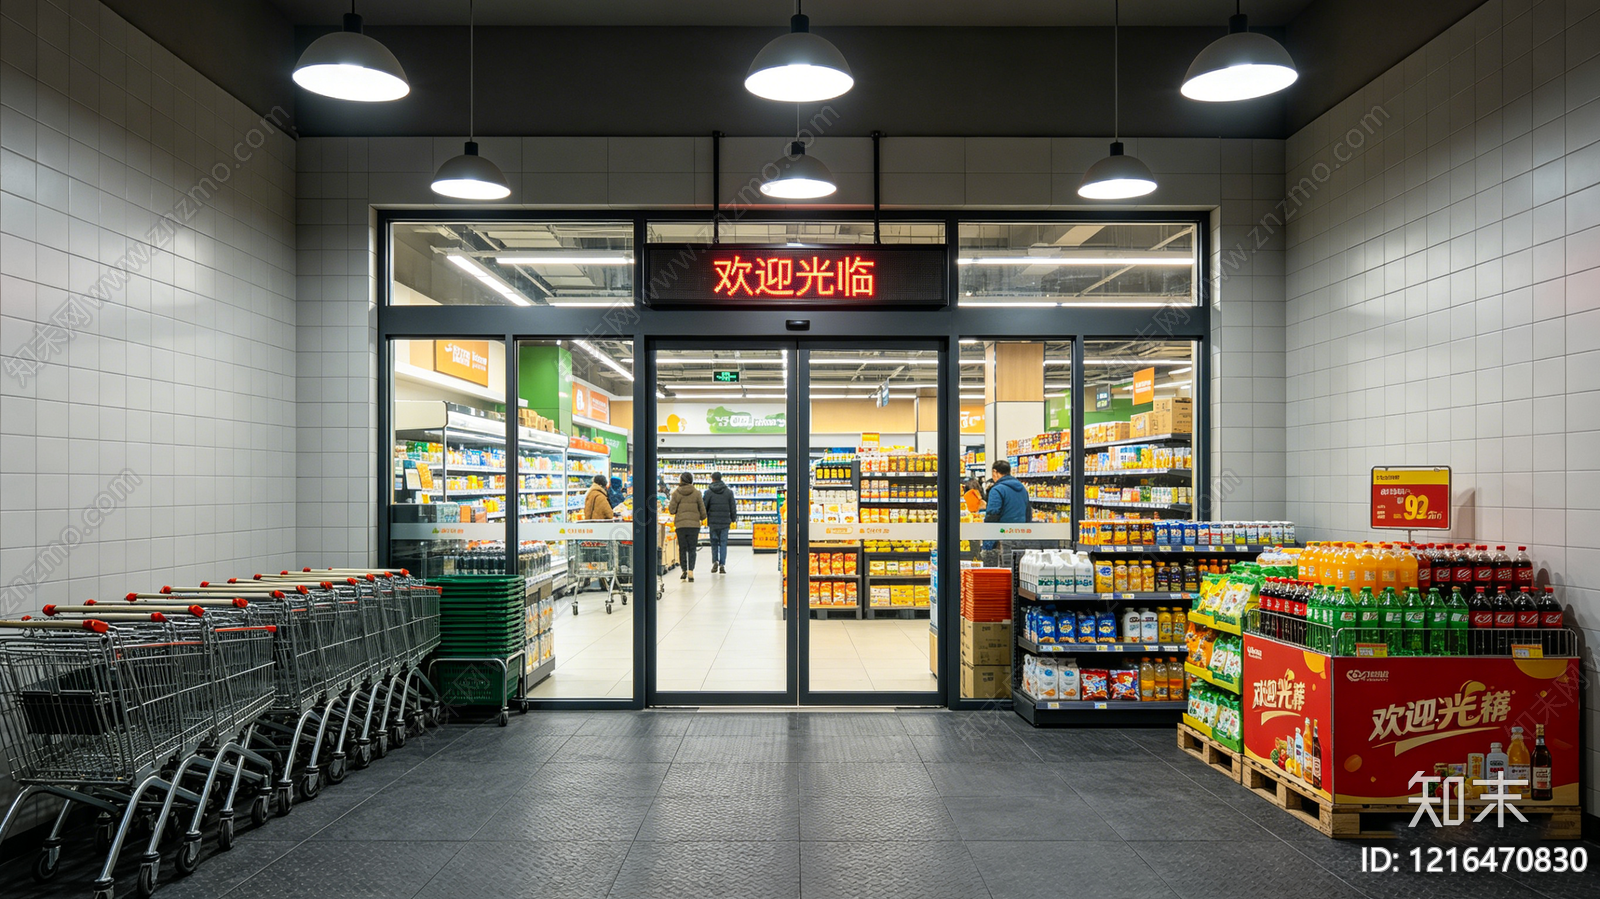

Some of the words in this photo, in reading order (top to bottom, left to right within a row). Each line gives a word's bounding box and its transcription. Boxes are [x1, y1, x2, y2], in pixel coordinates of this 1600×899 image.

[712, 255, 875, 298] 欢迎光临
[1403, 494, 1429, 520] 92
